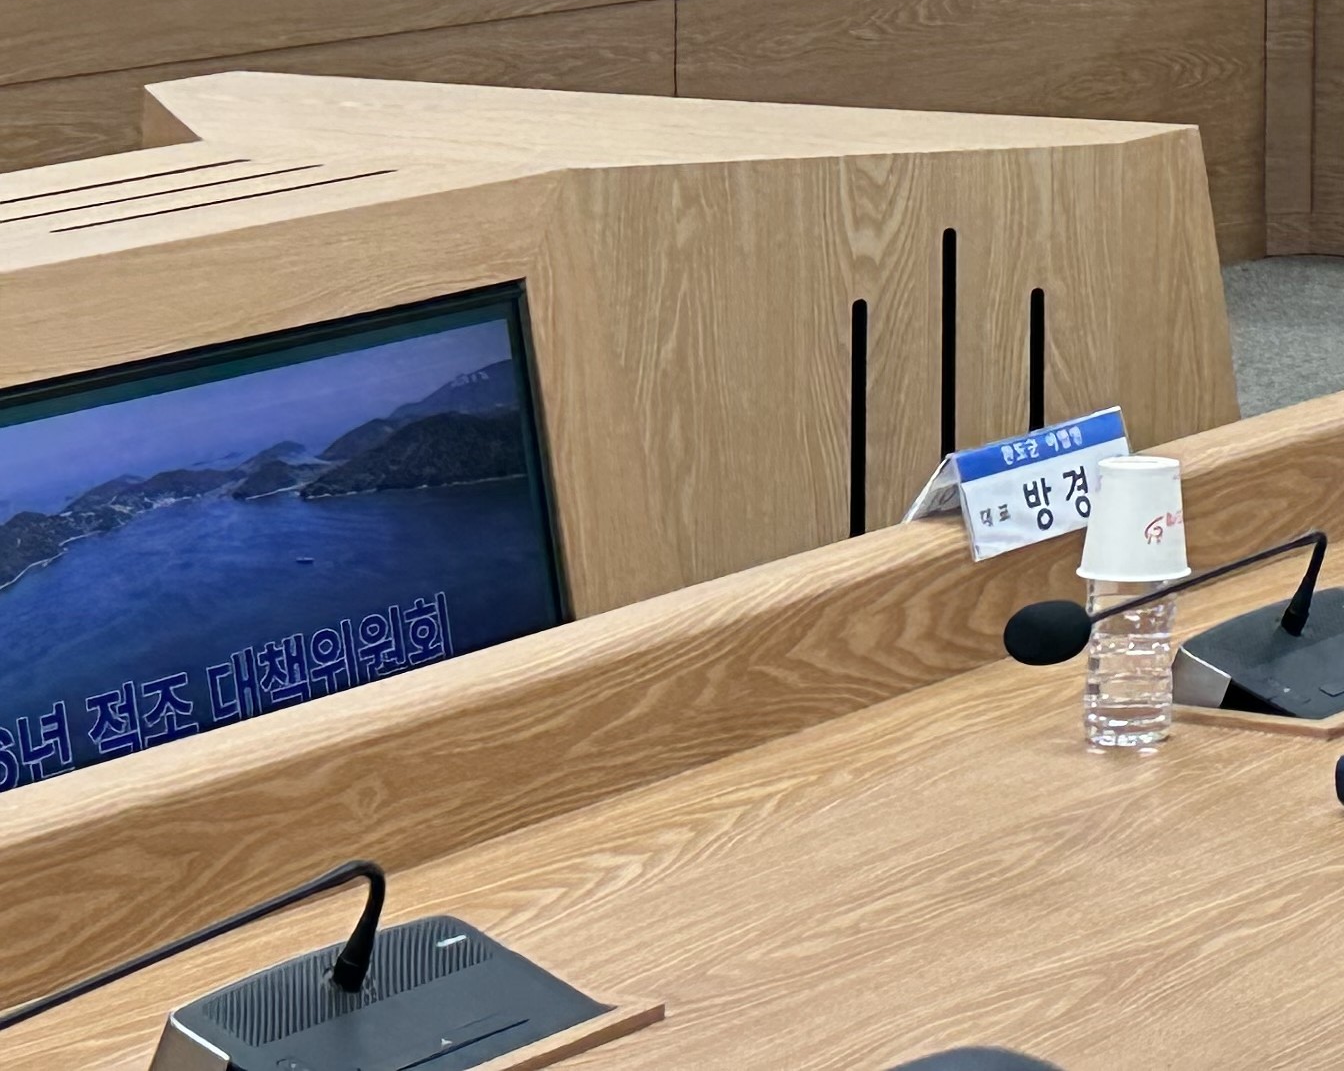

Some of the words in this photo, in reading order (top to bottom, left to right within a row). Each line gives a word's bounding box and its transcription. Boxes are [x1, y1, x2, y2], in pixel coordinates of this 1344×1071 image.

[1022, 465, 1092, 531] 방경
[85, 671, 200, 754] 적조
[205, 591, 454, 721] 대책위원회
